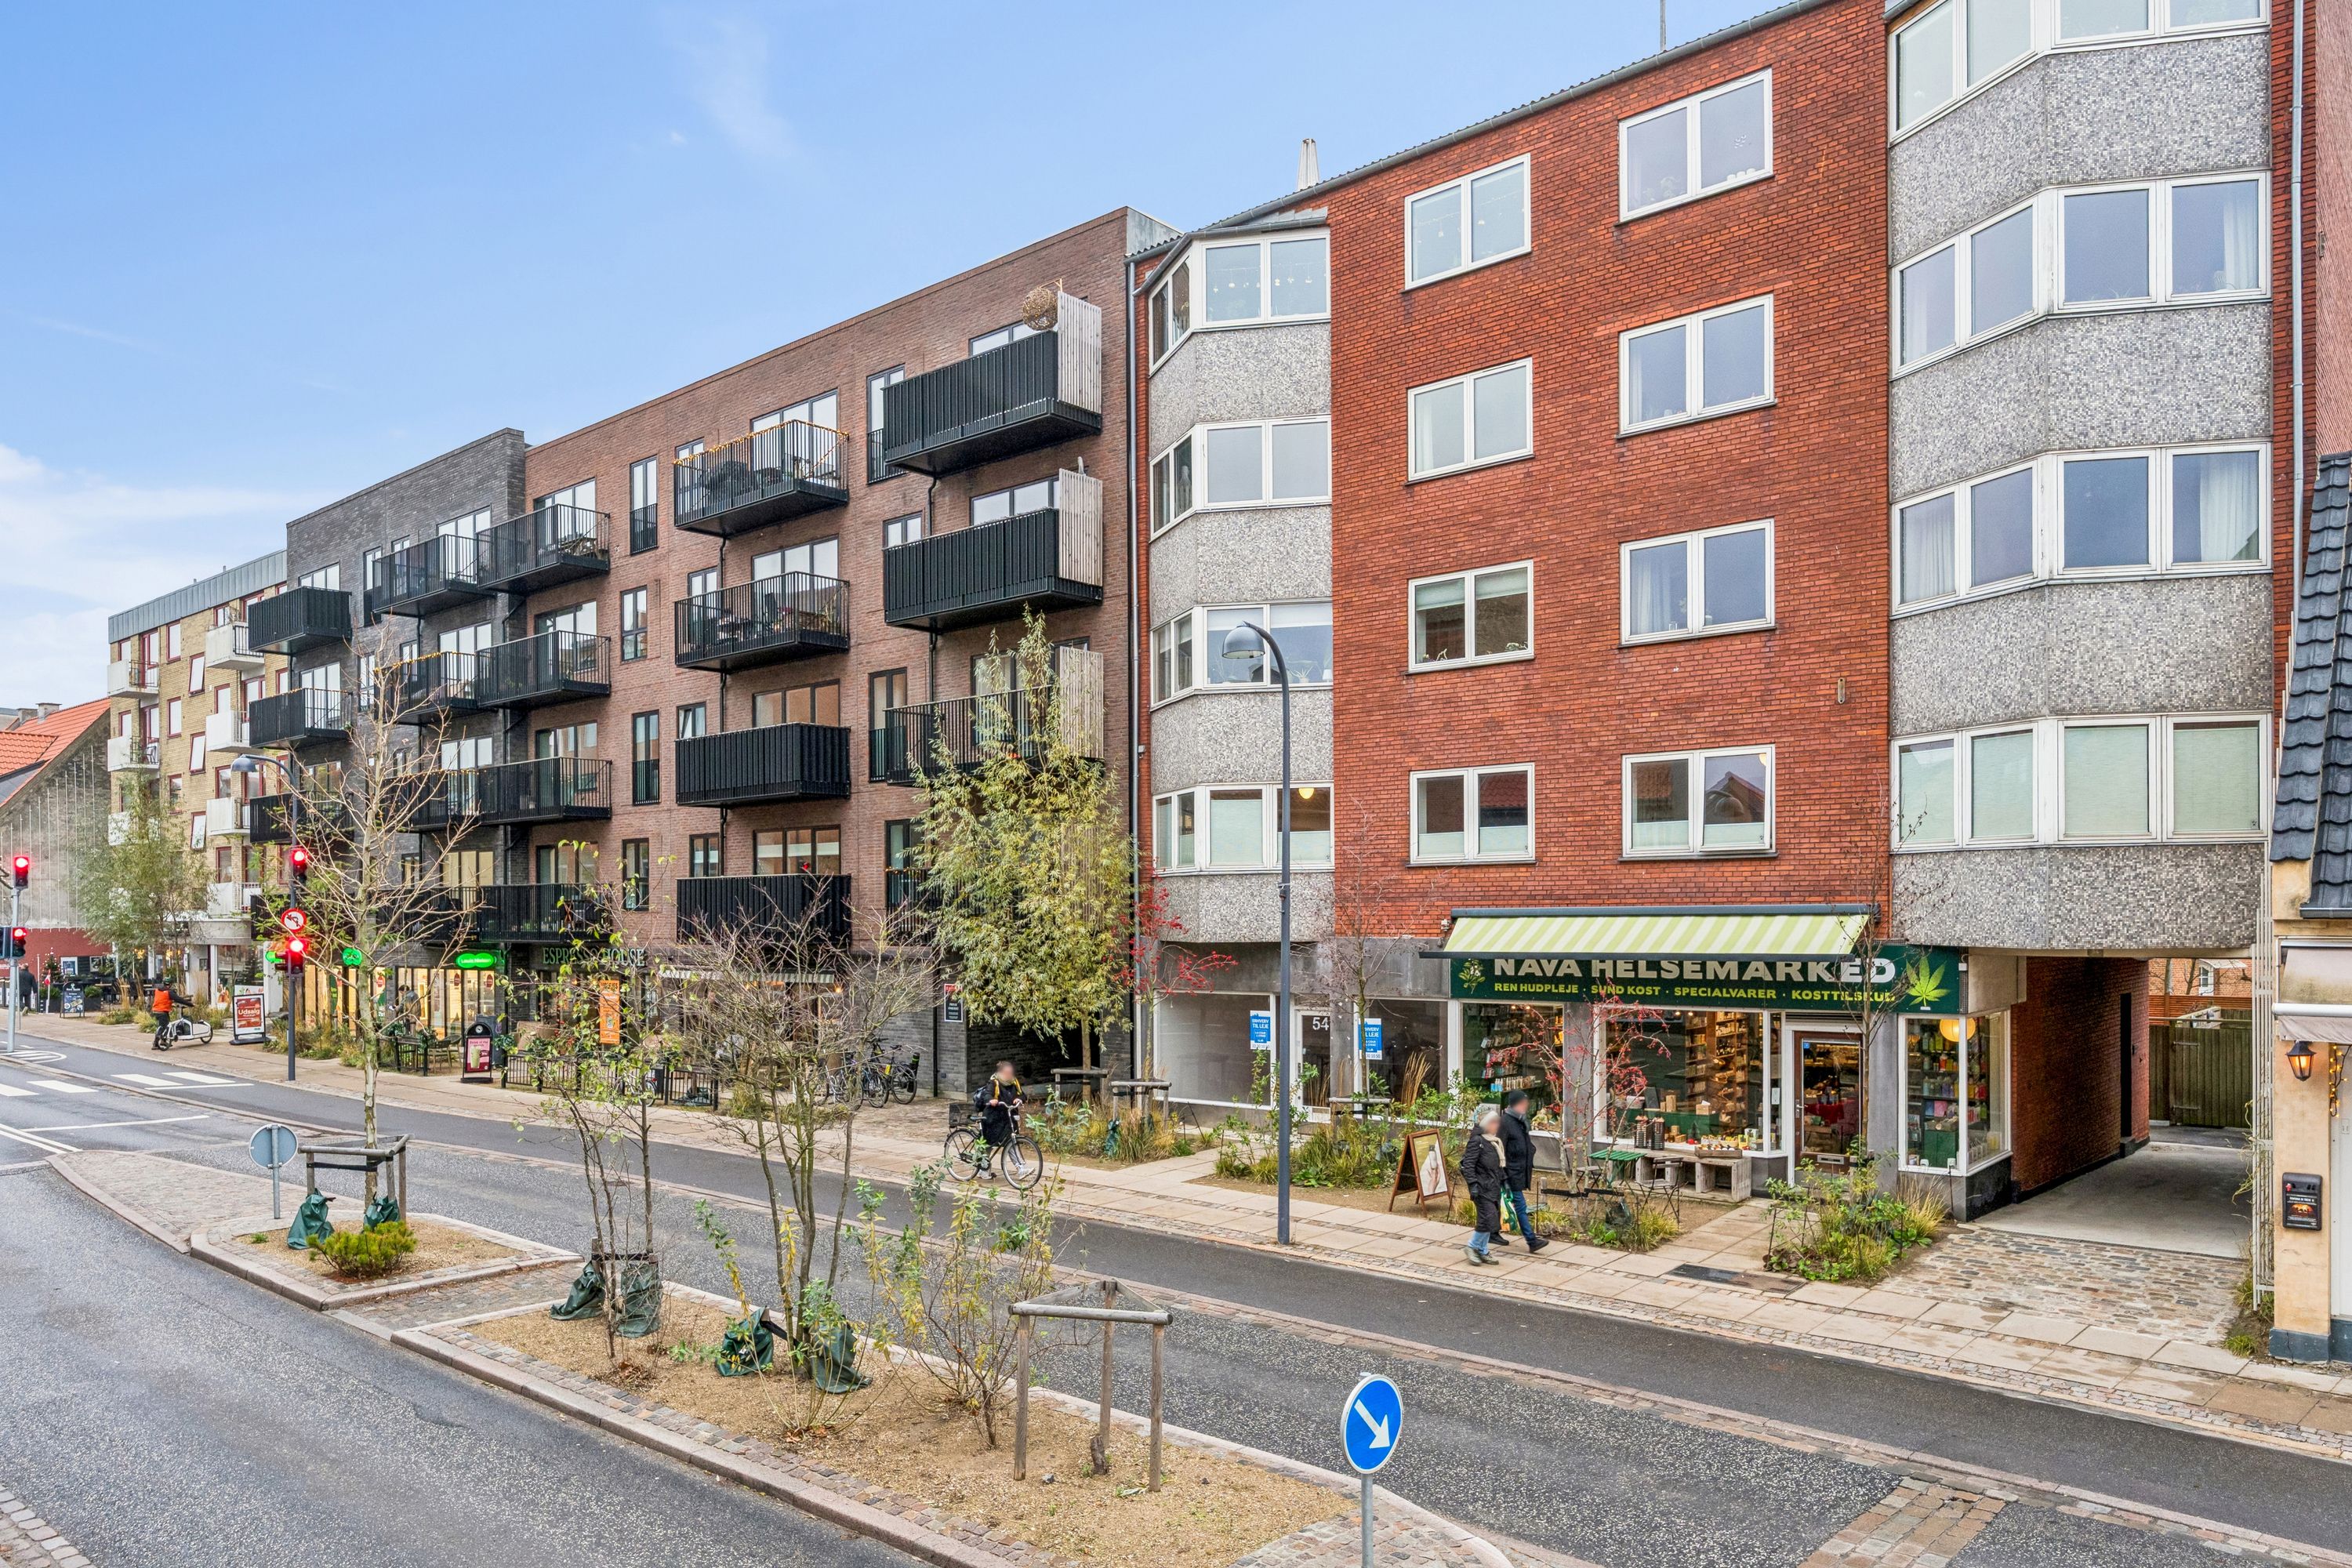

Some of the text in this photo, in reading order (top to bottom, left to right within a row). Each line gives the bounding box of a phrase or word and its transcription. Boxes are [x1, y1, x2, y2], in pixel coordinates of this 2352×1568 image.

[1494, 957, 1896, 983] NAVA HELSEMARKED
[1494, 982, 1518, 992] REN
[1519, 983, 1578, 993] HUDPLEJE
[1591, 985, 1624, 994] SUND
[1627, 985, 1661, 996] KOST
[1674, 987, 1777, 999] SPECIALVARER
[1312, 1017, 1329, 1031] 54
